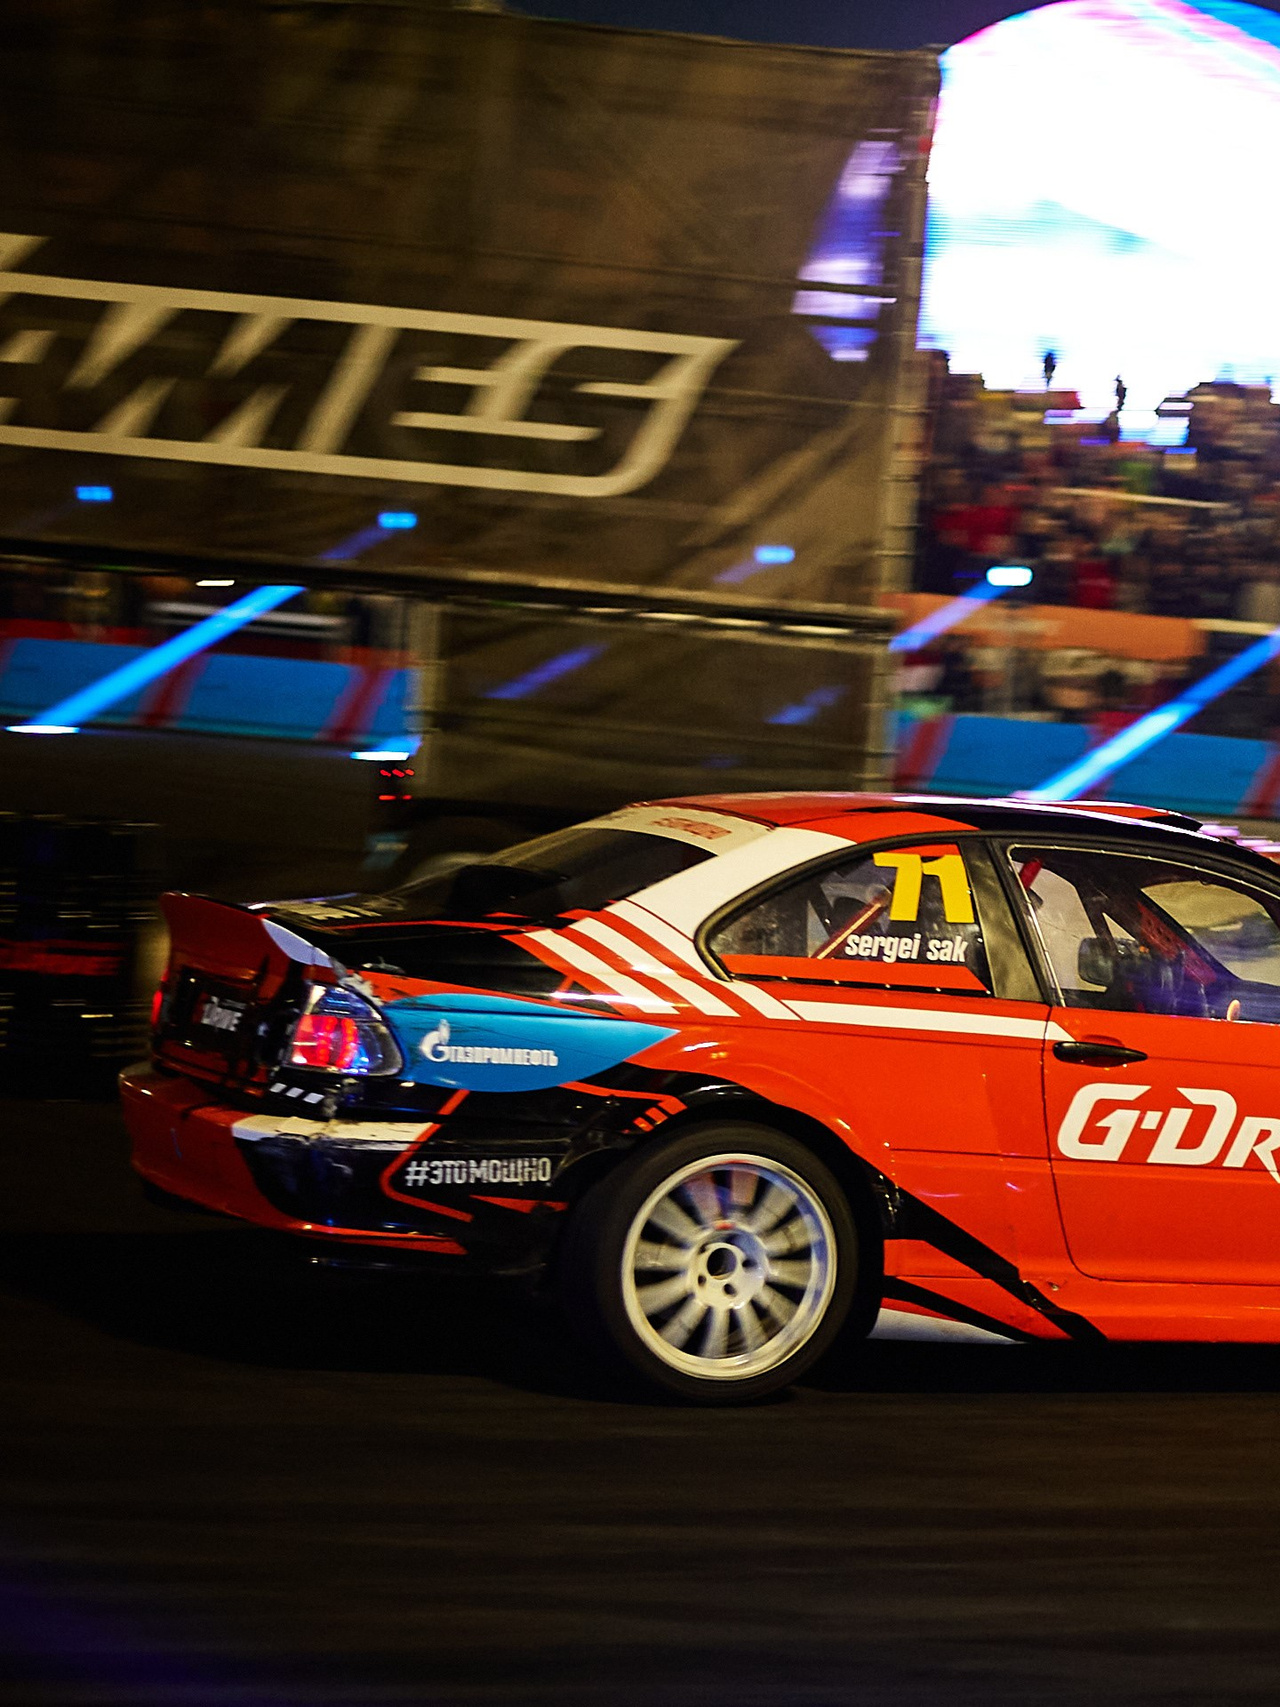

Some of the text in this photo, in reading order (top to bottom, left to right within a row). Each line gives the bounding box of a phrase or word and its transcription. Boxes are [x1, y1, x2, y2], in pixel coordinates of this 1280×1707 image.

[872, 852, 975, 923] 71
[845, 933, 968, 963] sergei sak
[405, 1157, 551, 1186] #ЭТОМОЩНО
